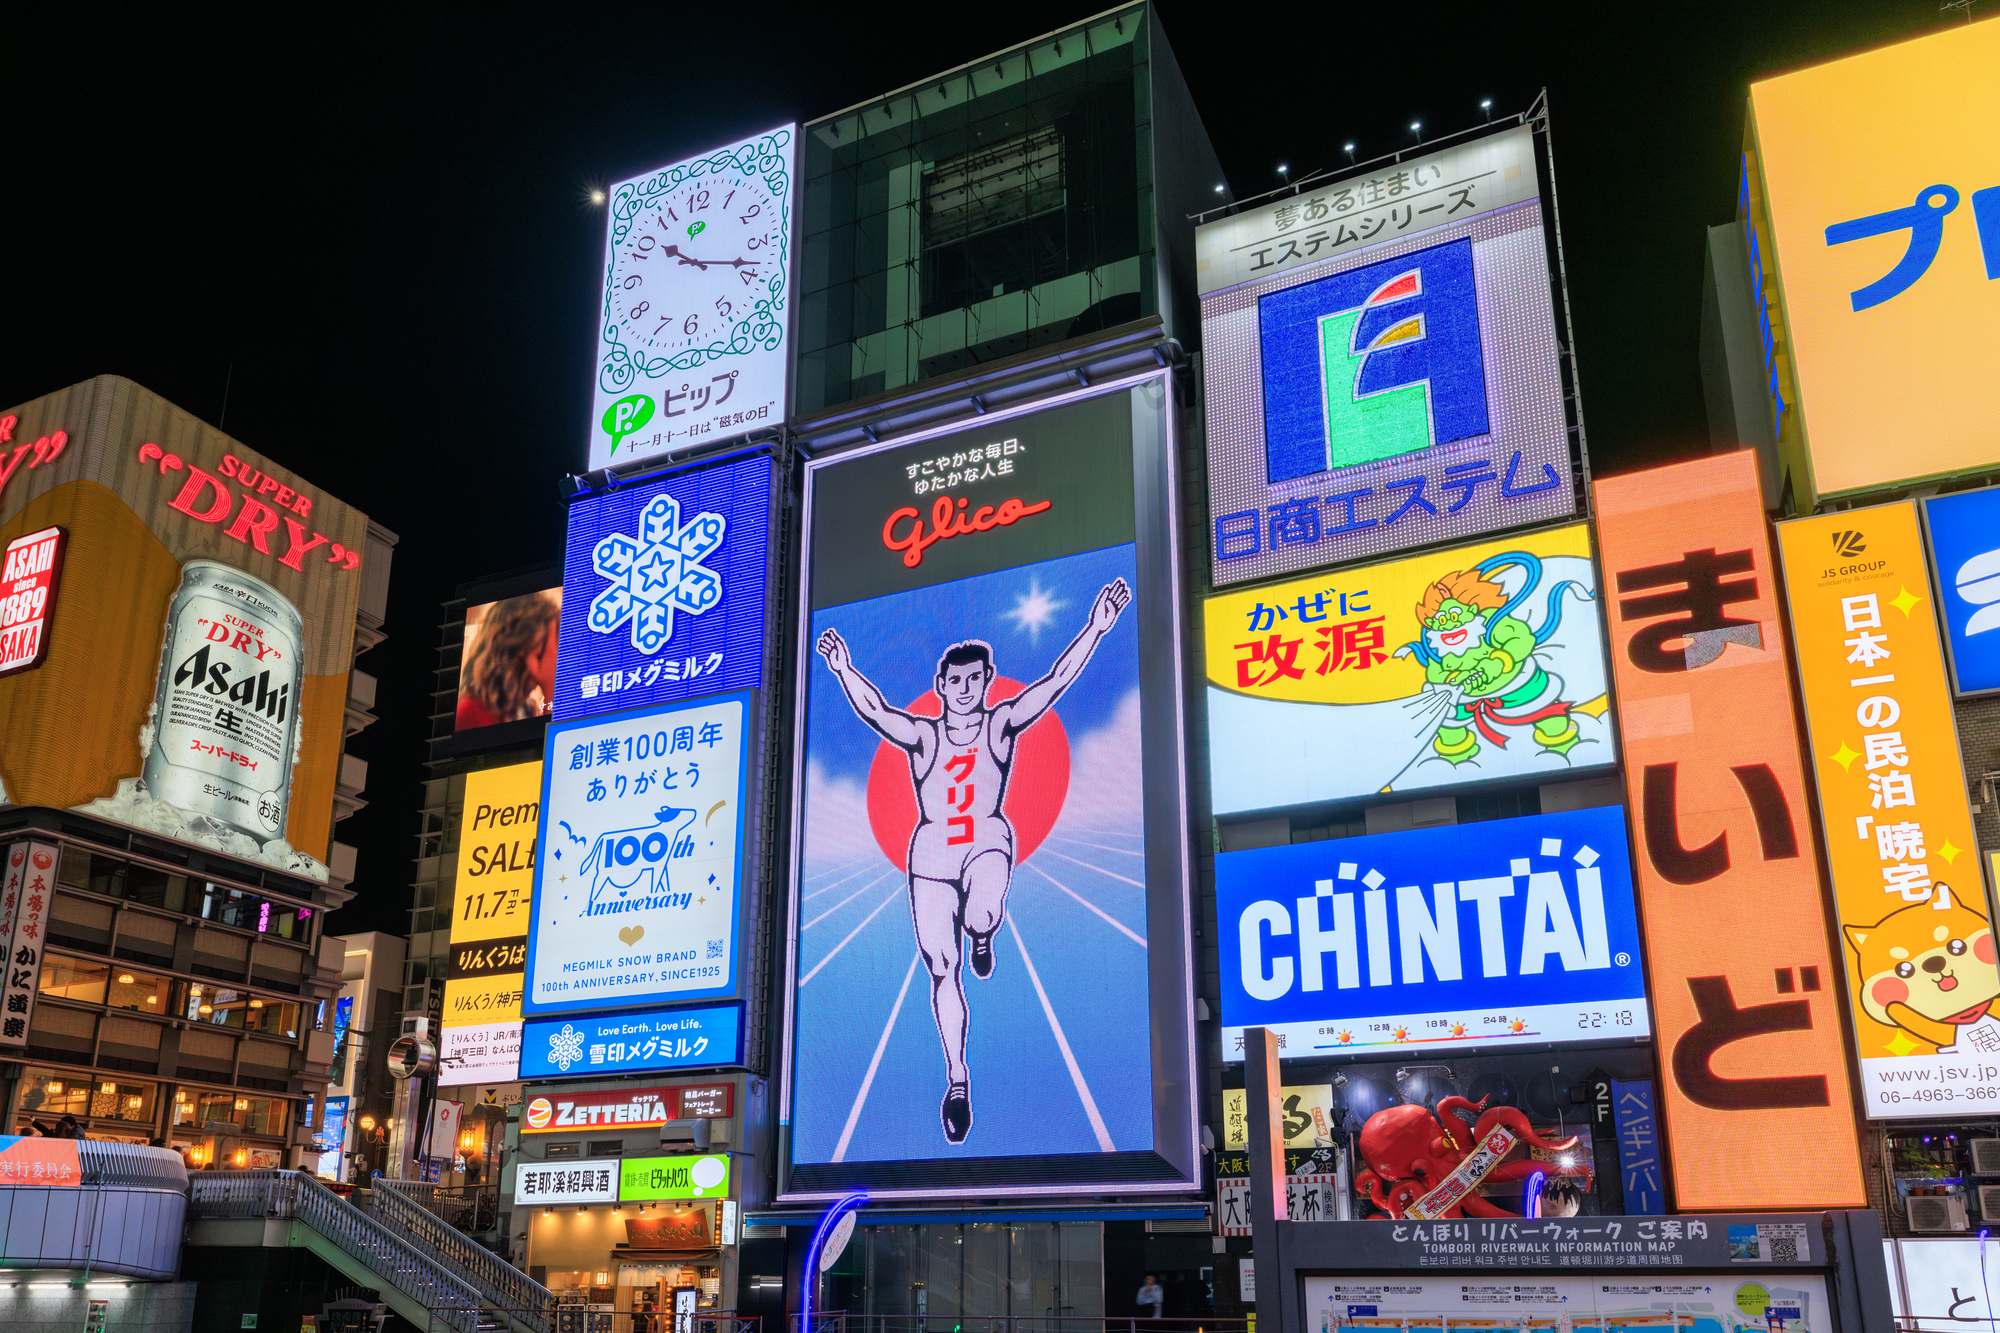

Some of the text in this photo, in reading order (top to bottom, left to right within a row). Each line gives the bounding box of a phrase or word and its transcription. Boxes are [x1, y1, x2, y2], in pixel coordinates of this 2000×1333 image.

[686, 190, 710, 213] 12
[722, 189, 735, 210] 1
[1273, 165, 1441, 232] 夢ある住まい
[657, 207, 678, 230] 11
[739, 204, 761, 225] 2
[1250, 184, 1476, 272] エステムシリーズ
[632, 235, 655, 262] 10
[748, 233, 768, 250] 3
[1825, 184, 2000, 312] プ
[624, 275, 643, 290] 9
[739, 268, 759, 285] 4
[631, 301, 650, 319] 8
[715, 295, 732, 317] 5
[654, 316, 672, 336] 7
[684, 314, 699, 335] 6
[664, 369, 739, 418] ピップ
[906, 438, 1026, 479] すこやかな毎日、
[217, 454, 313, 518] SUPER
[914, 459, 1014, 495] ゆたかな人生
[1216, 450, 1561, 560] 日商エステム
[3, 538, 56, 583] ASAHI
[1821, 560, 1887, 579] JS GROUP
[13, 577, 37, 593] since
[1817, 571, 1895, 588] solidarity & courage
[1247, 587, 1371, 632] かぜに
[223, 614, 264, 638] SUPER
[1233, 614, 1389, 688] 改源
[174, 644, 289, 724] Asahi
[581, 652, 724, 699] 雪印メグミルク
[214, 707, 244, 736] 生
[190, 739, 258, 771] スーパードライ
[569, 721, 723, 771] 創業100周年
[586, 762, 700, 802] ありがとう
[943, 747, 978, 847] グリコ
[1615, 547, 1831, 1113] まいど
[22, 874, 46, 940] 本場の味
[463, 890, 508, 921] 11.7
[579, 891, 693, 918] Anniversary
[459, 944, 526, 970] りんくうは
[562, 950, 697, 973] MEGMILK SNOW BRAND
[541, 982, 569, 993] 100th
[598, 1018, 702, 1037] Love Earth. Love Life.
[1578, 1010, 1633, 1029] 22:18
[589, 1036, 708, 1064] 雪印メグミルク
[1879, 1063, 1998, 1084] www.jsv.jp
[632, 1095, 659, 1103] ゼッテリア
[695, 1107, 722, 1115] コーヒー
[555, 1102, 667, 1126] ZETTERIA
[1229, 1094, 1244, 1143] 道頓堀
[1619, 1091, 1658, 1213] ペンギンバー
[650, 1166, 689, 1189] ピタットハウス
[1318, 1162, 1333, 1173] 2F
[1323, 1189, 1334, 1217] 検索
[1391, 1219, 1709, 1243] とんぼり リバーウォーク ご案内
[1423, 1241, 1676, 1254] TOMBORI RIVERWALK INFORMATION MAP
[1452, 1255, 1472, 1266] 리버
[1474, 1255, 1495, 1266] 워크
[1497, 1255, 1518, 1266] 주변
[1520, 1255, 1552, 1266] 안내도
